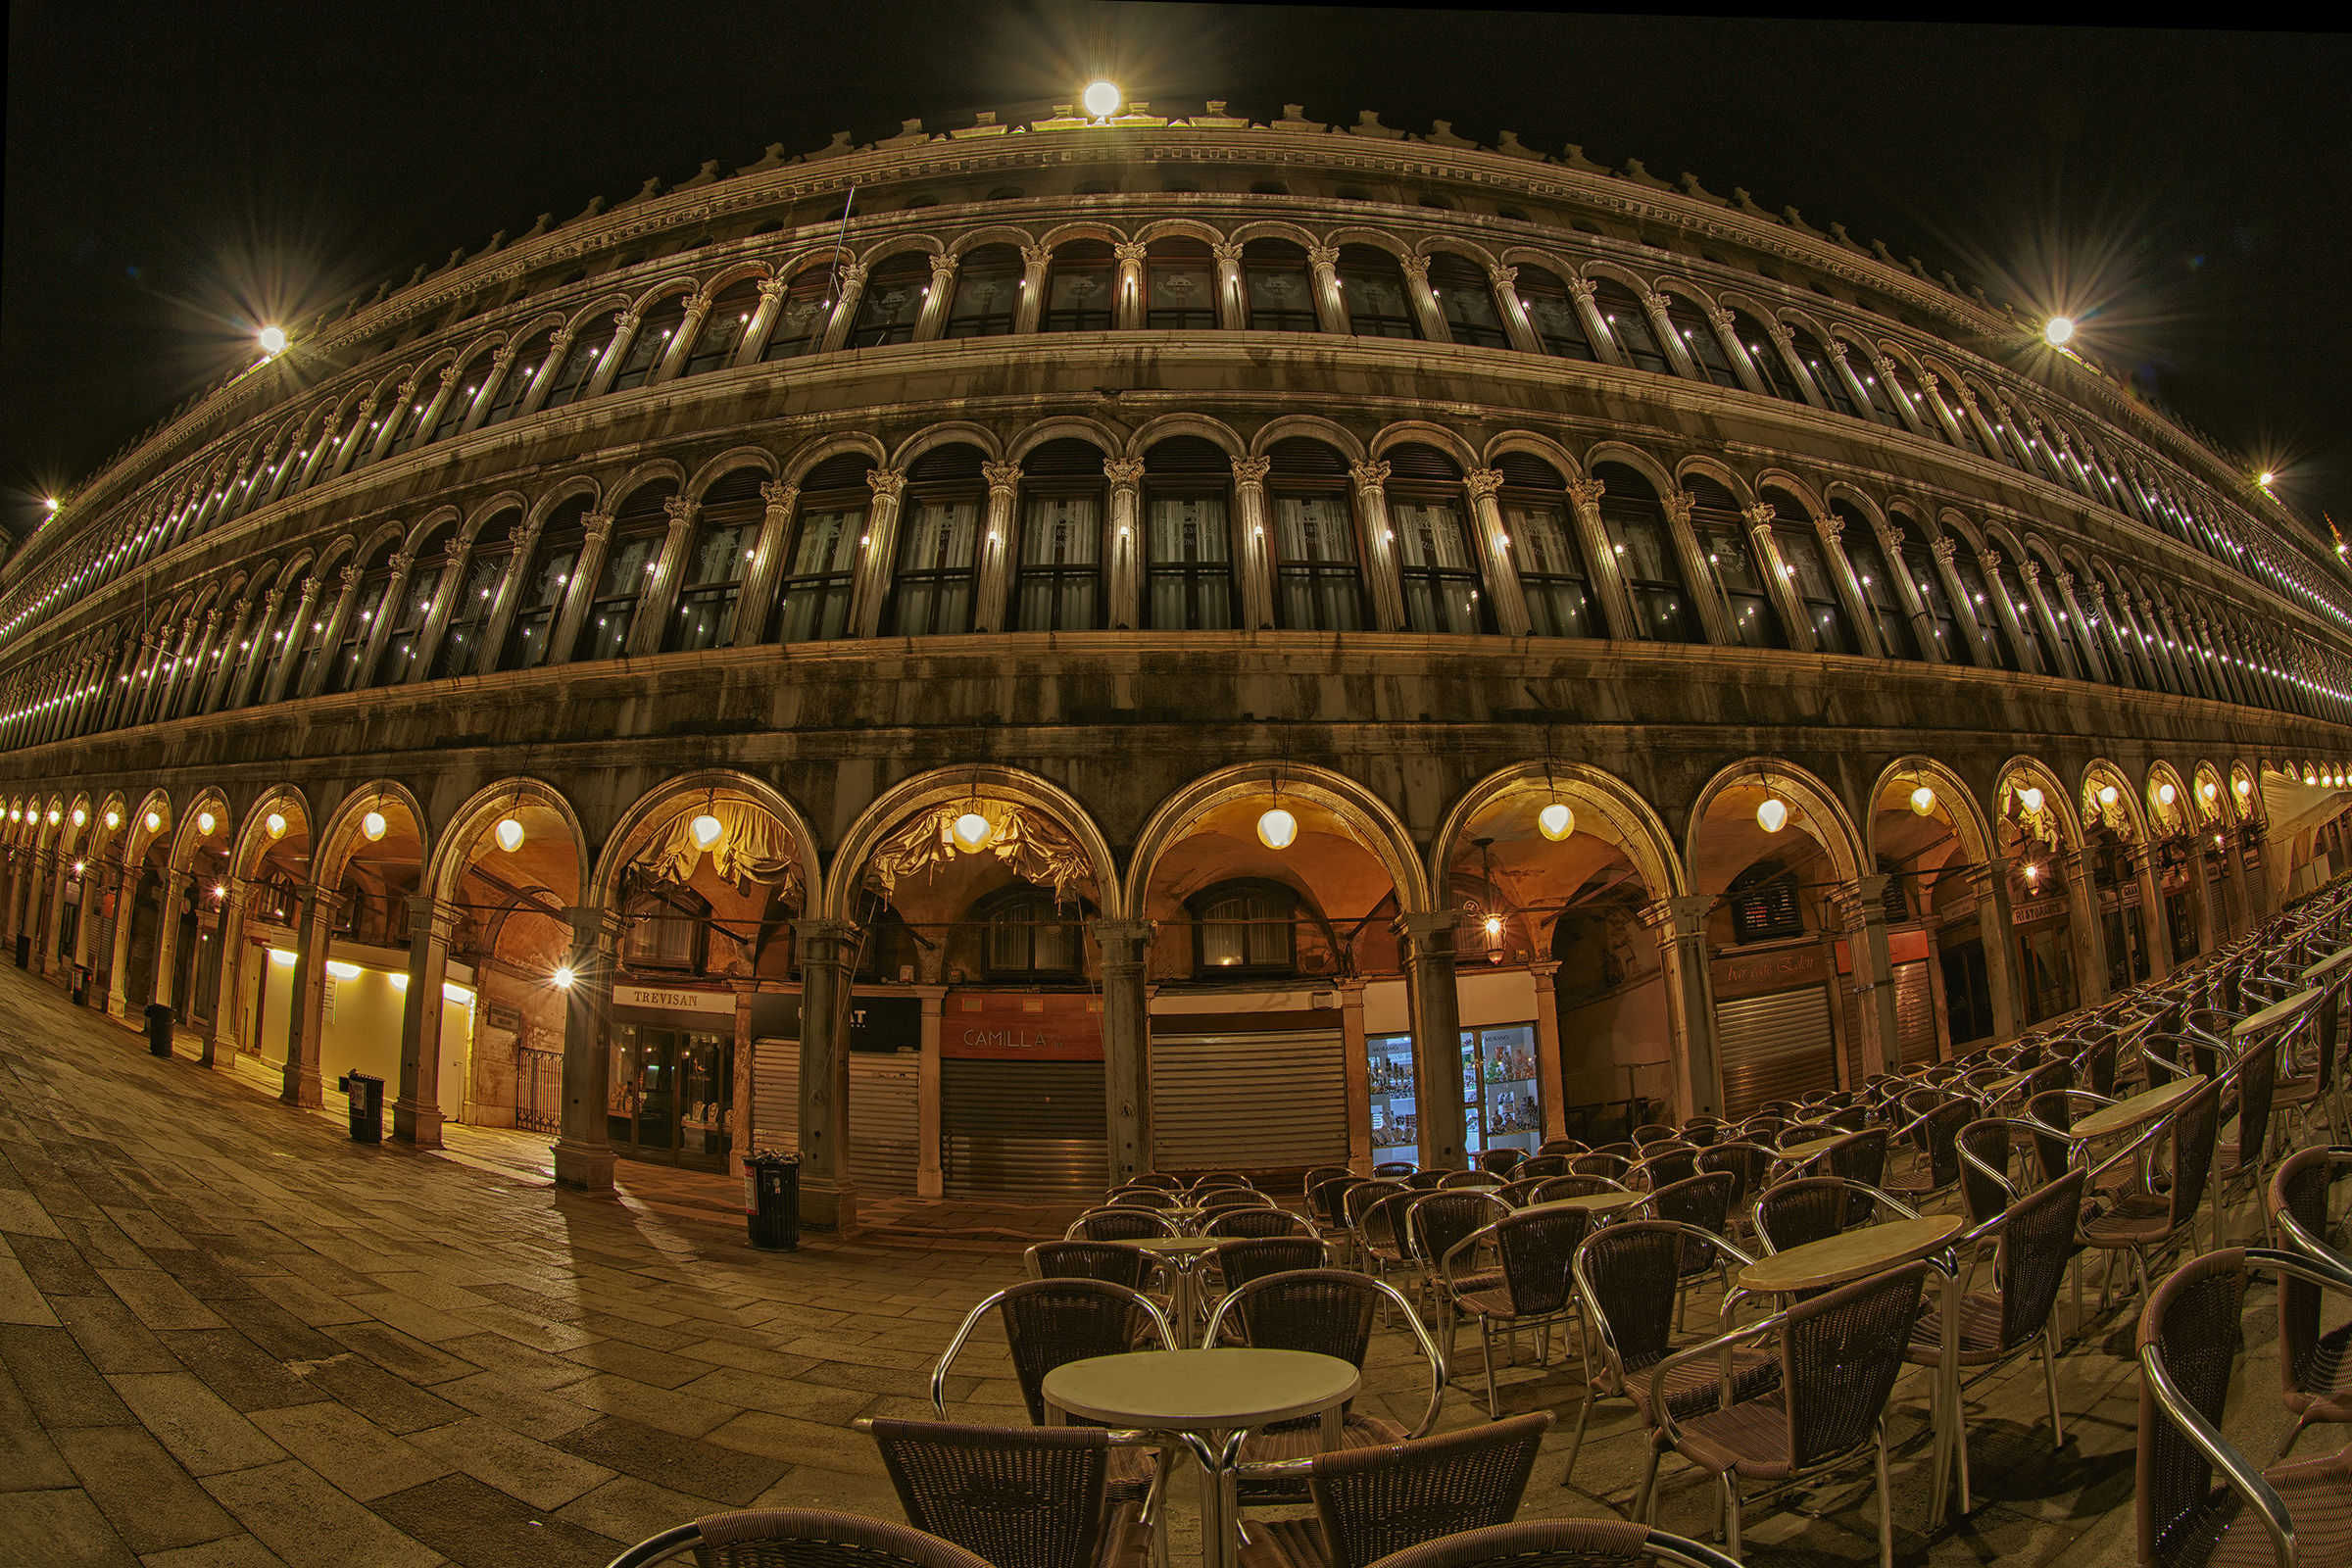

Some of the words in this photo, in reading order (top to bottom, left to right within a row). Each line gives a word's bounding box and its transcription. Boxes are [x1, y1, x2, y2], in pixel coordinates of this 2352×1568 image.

[2015, 903, 2062, 922] RISTORANTE
[634, 991, 698, 1006] TREVISAN
[963, 1030, 1047, 1048] CAMILLA
